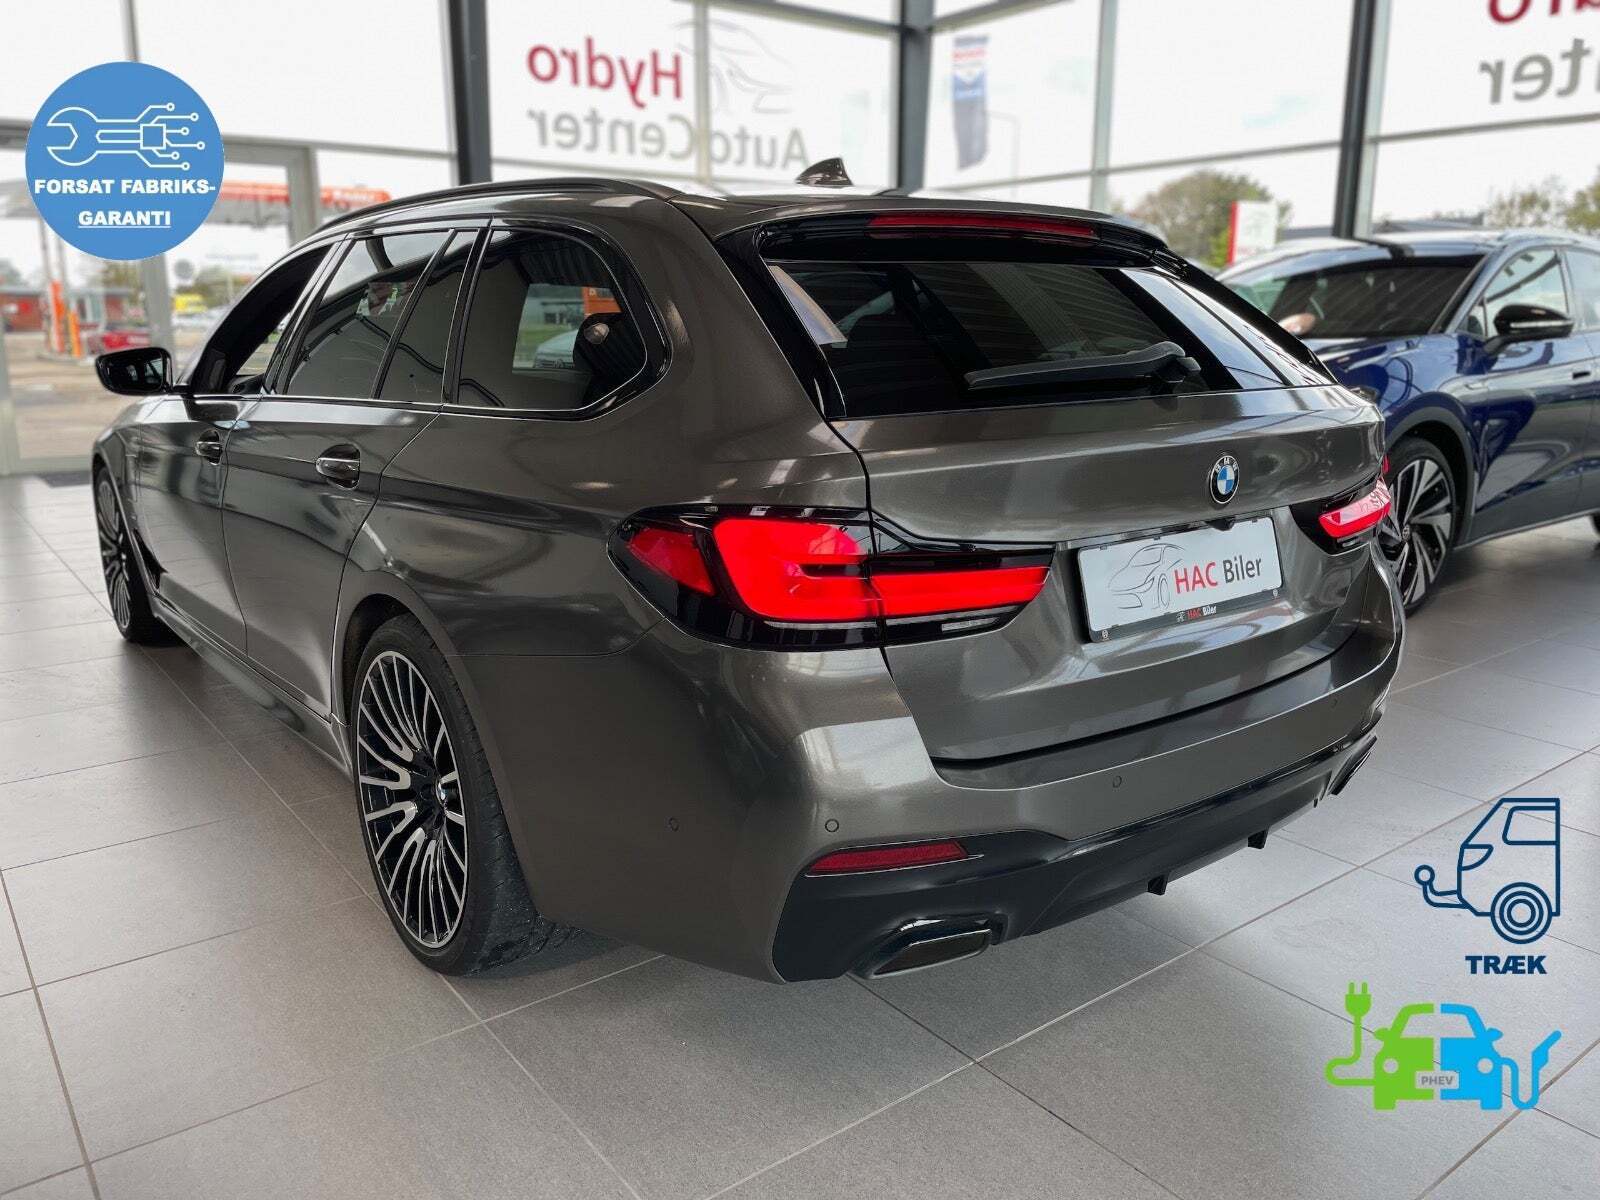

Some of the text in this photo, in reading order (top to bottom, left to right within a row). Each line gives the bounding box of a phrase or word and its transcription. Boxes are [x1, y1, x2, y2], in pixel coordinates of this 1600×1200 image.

[1174, 554, 1262, 594] HAC Biler
[1187, 605, 1217, 620] HAC Biler
